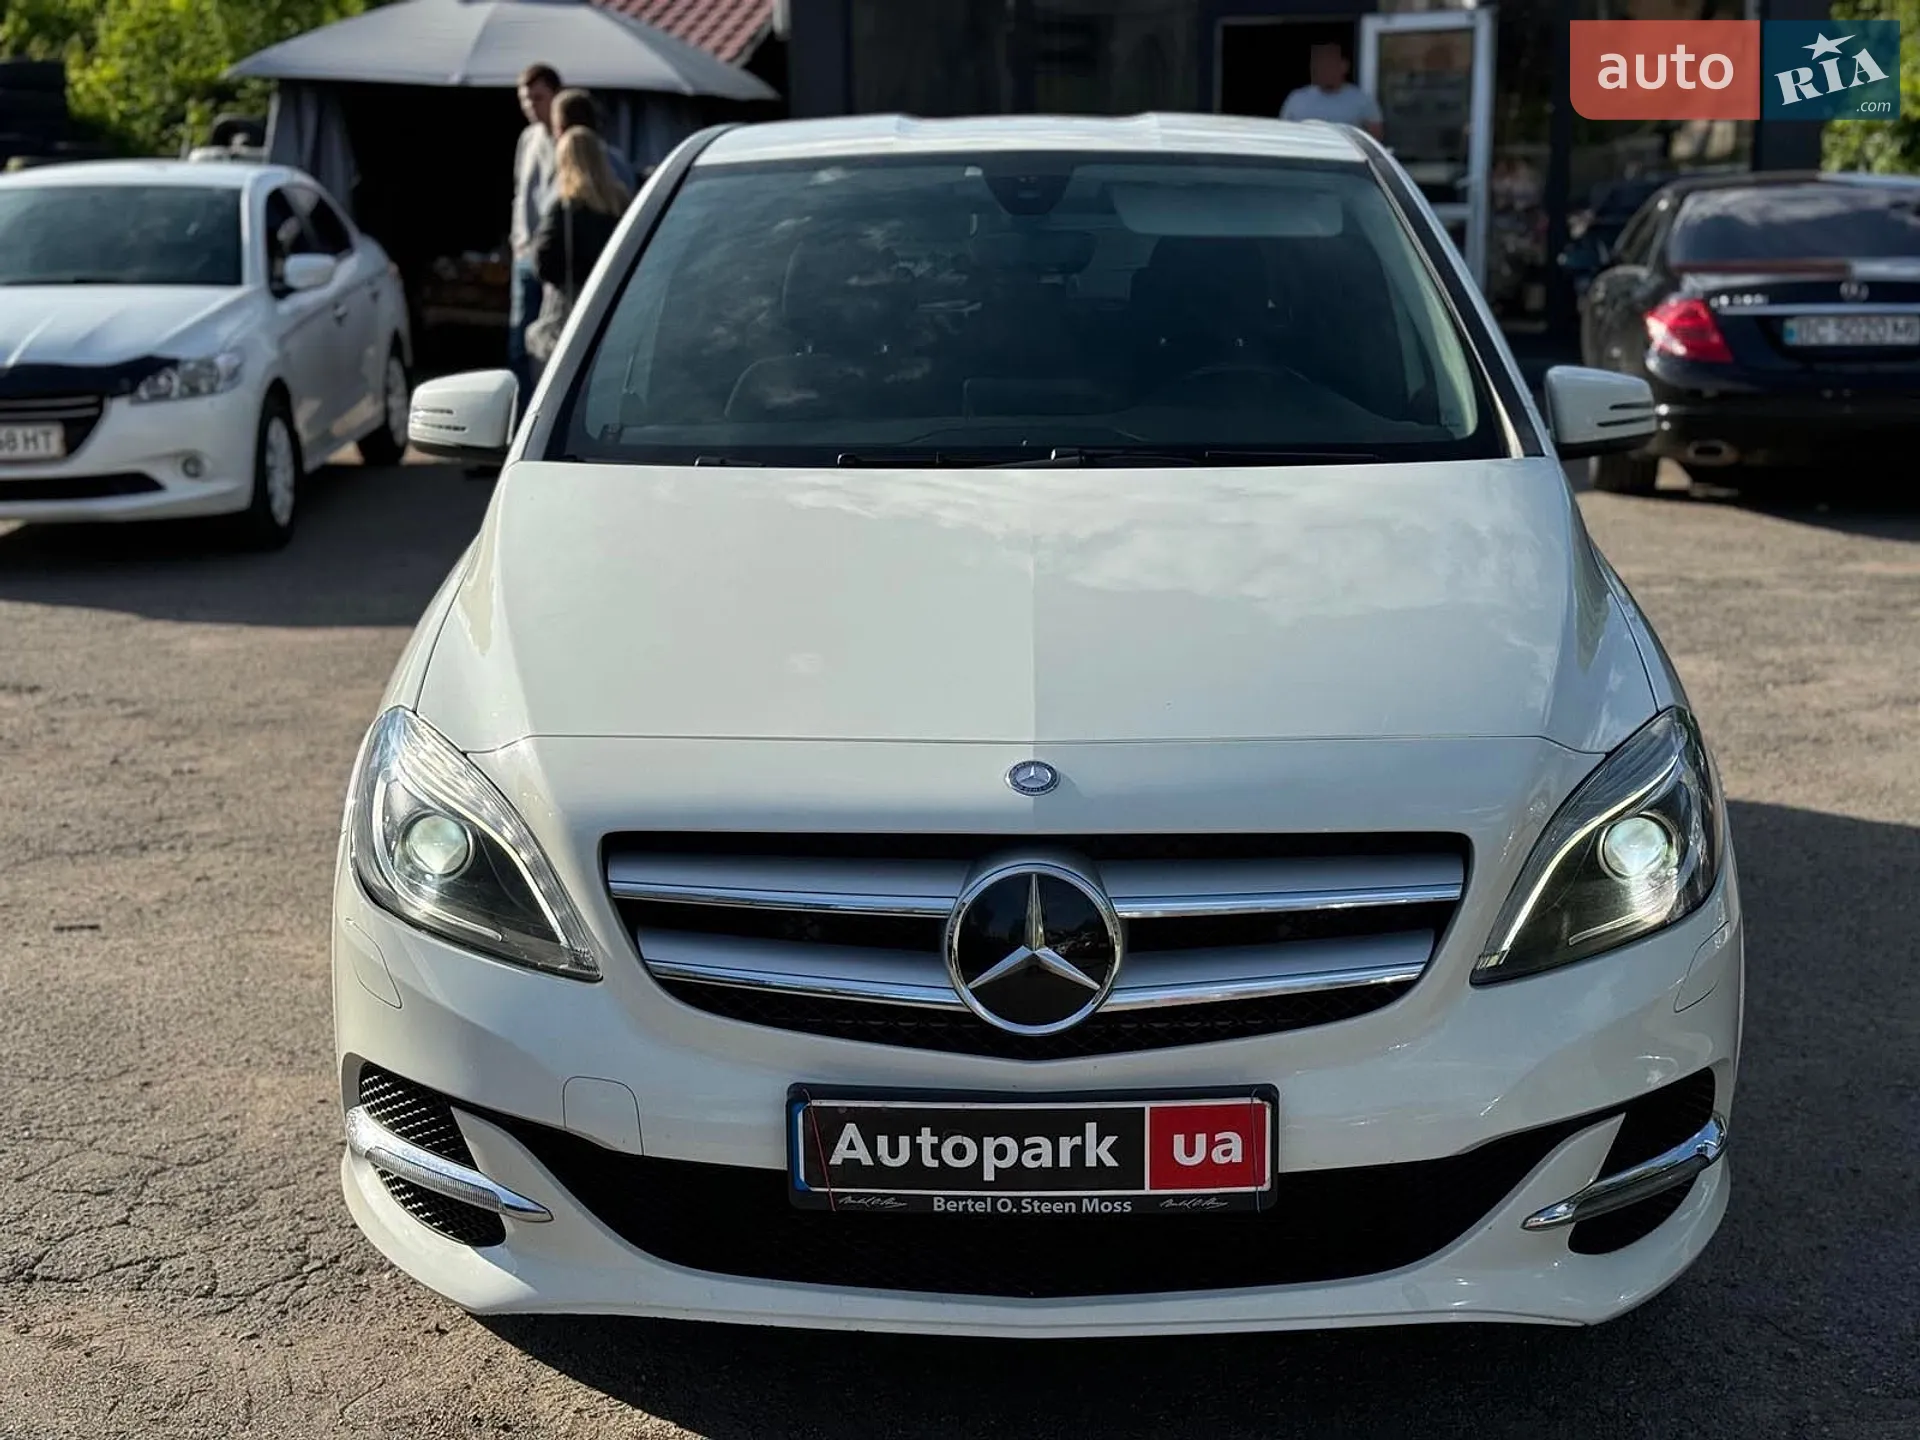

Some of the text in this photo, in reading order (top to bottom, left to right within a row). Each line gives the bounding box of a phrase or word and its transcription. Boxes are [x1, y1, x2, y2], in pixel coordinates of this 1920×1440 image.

[829, 1122, 1243, 1181] Autopark ua
[933, 1196, 1132, 1214] Bertel O. Steen Moss
